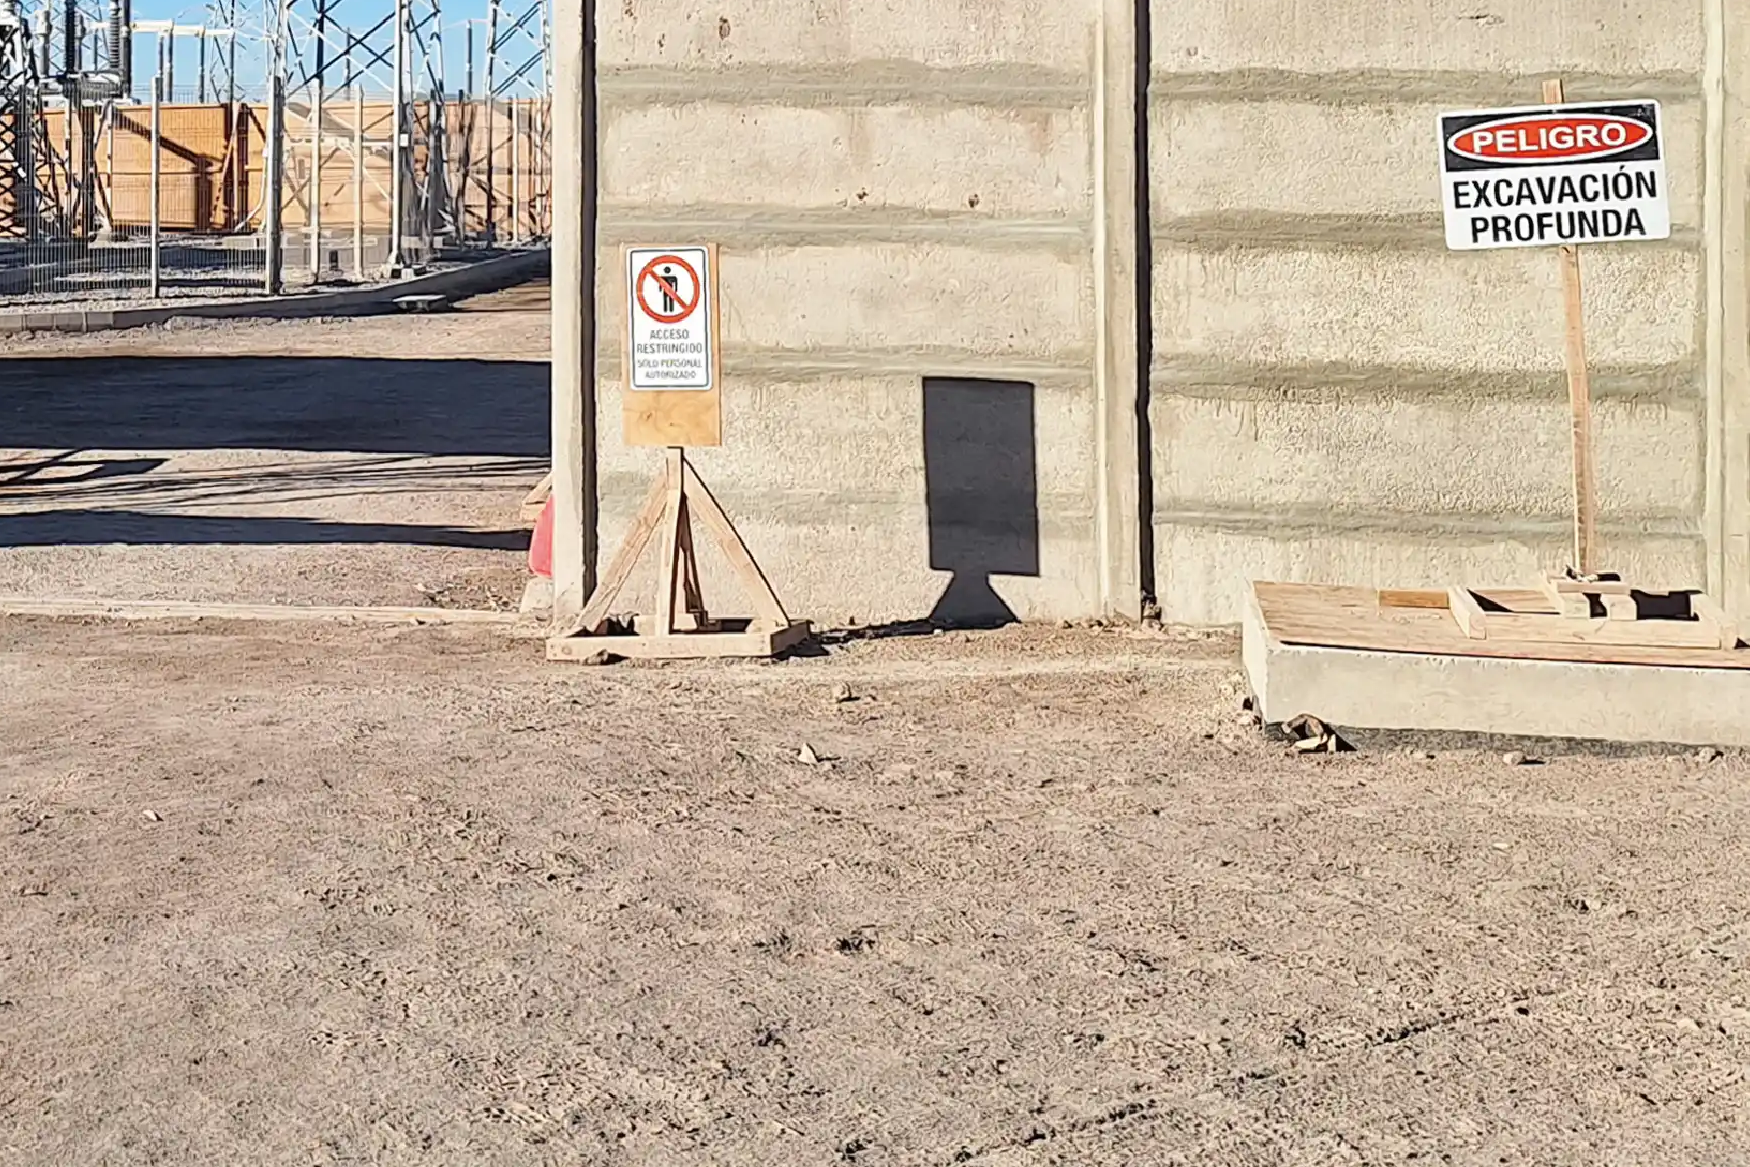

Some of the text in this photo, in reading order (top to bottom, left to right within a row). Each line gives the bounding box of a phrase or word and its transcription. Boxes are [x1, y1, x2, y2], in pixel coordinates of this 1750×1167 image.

[1472, 122, 1627, 154] PELIGRO
[1453, 165, 1657, 209] EXCAVACIÓN
[1470, 208, 1647, 243] PROFUNDA
[650, 329, 690, 340] ACCESO
[637, 342, 703, 354] RESTRINGIDO
[661, 358, 702, 368] PERSONAL
[645, 370, 697, 379] AUTORIZADO
